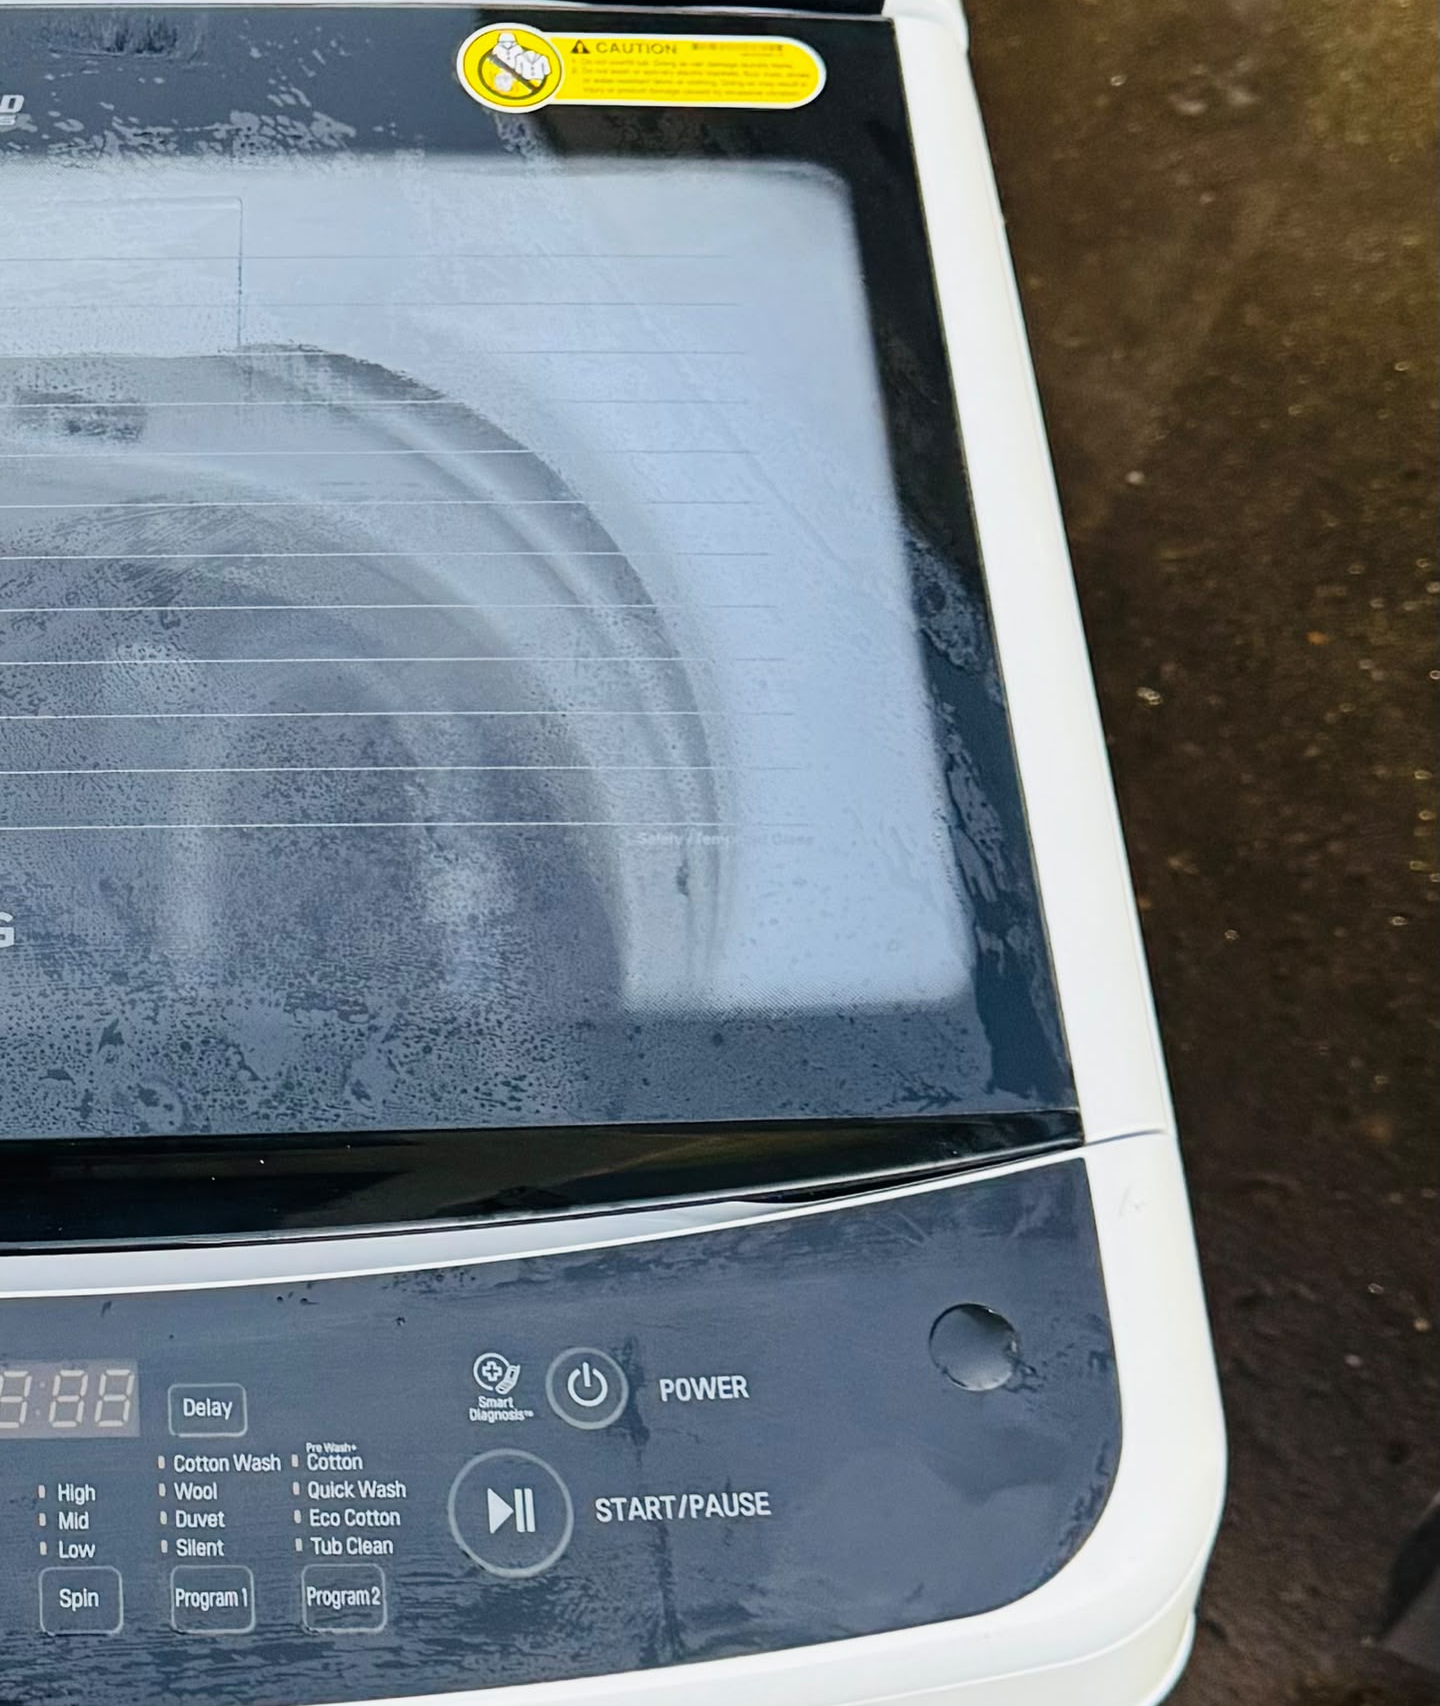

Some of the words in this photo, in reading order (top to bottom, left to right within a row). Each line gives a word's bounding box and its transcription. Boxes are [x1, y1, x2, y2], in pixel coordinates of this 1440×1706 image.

[596, 42, 677, 54] CAUTION
[659, 1375, 750, 1402] POWER
[182, 1398, 234, 1422] Delay
[478, 1396, 514, 1409] Smart
[305, 1442, 322, 1453] Pre
[172, 1454, 228, 1473] Cotton
[232, 1453, 282, 1472] Wash
[306, 1453, 364, 1471] Cotton
[57, 1483, 96, 1506] High
[173, 1481, 218, 1501] Wool
[307, 1480, 356, 1500] Quick
[357, 1480, 407, 1499] Wash
[595, 1491, 772, 1522] START/PAUSE
[58, 1511, 89, 1530] Mid
[175, 1509, 226, 1528] Duvet
[309, 1508, 341, 1527] Eco
[344, 1508, 401, 1527] Cotton
[58, 1540, 96, 1559] Low
[175, 1538, 225, 1557] Silent
[309, 1536, 343, 1555] Tub
[346, 1536, 394, 1555] Clean
[59, 1587, 99, 1612] Spin
[174, 1588, 241, 1611] Program
